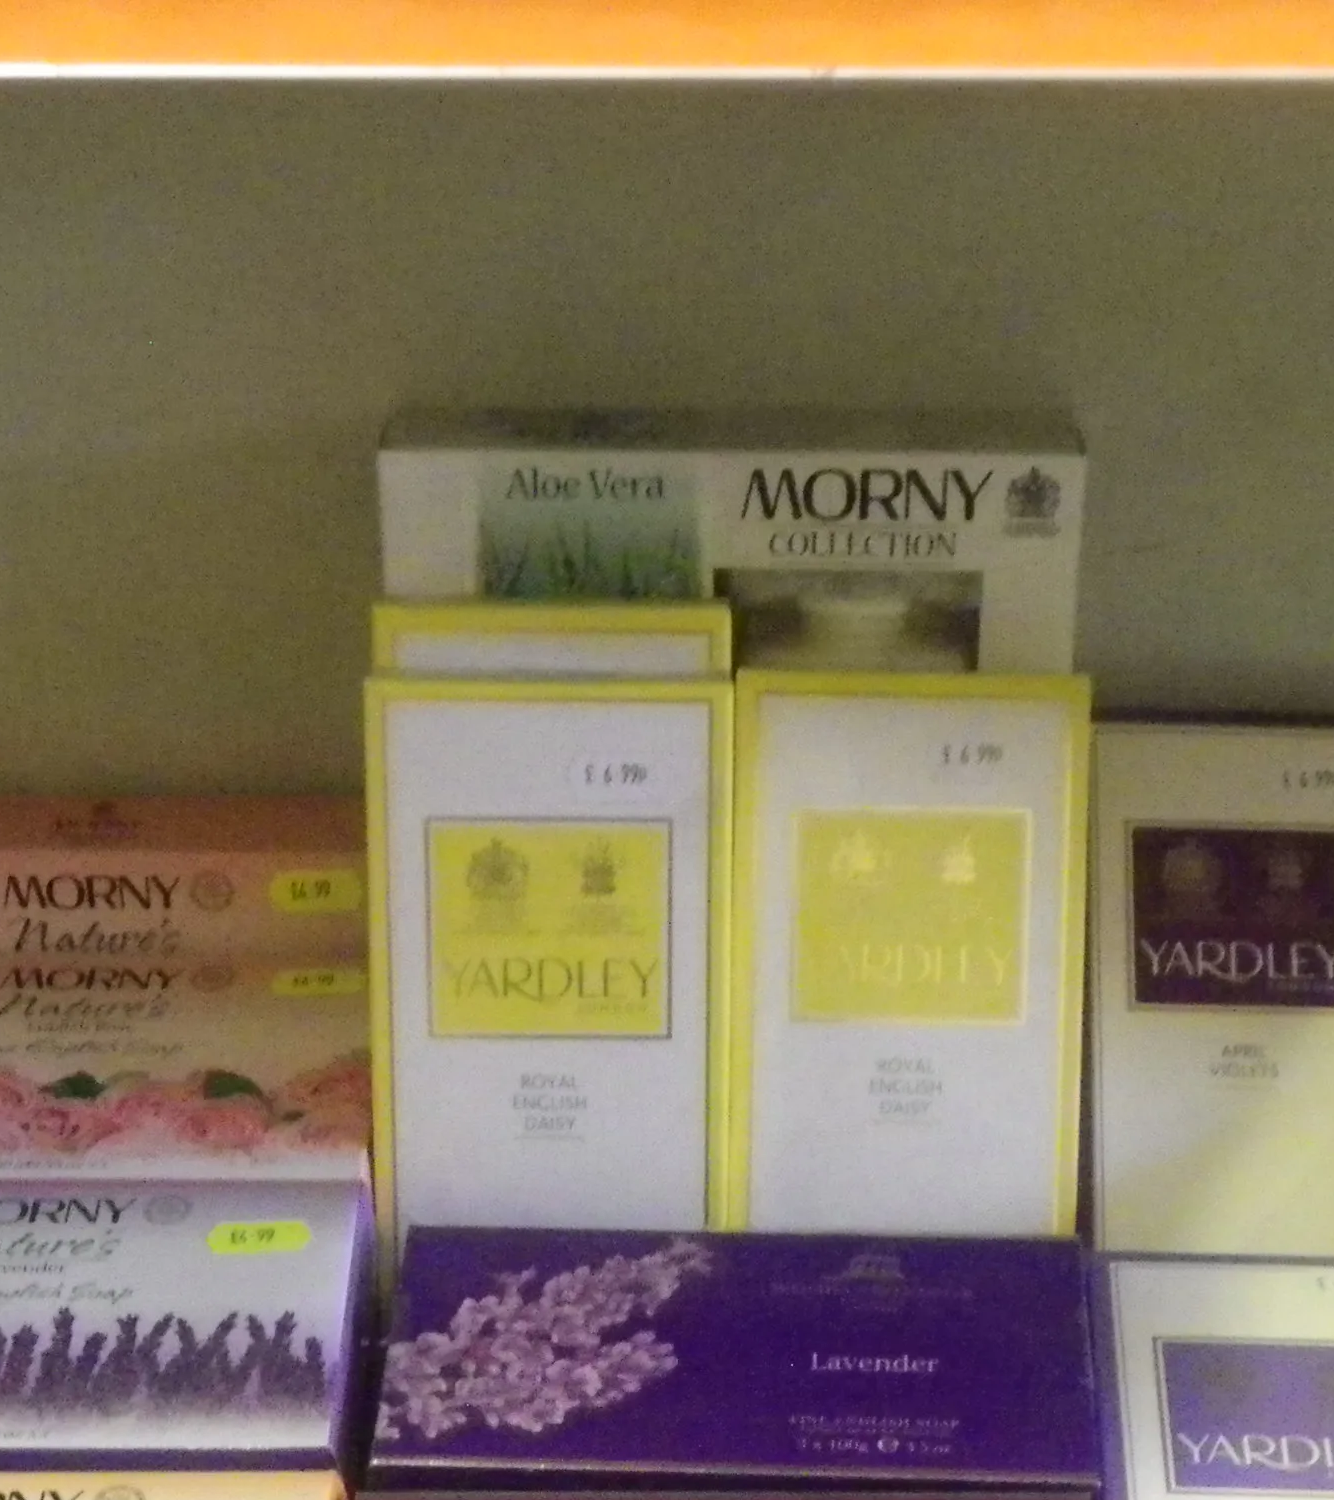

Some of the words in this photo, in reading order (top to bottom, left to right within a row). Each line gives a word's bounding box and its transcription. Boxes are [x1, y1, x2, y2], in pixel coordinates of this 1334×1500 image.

[506, 468, 581, 501] Aloe
[586, 468, 665, 501] Vera
[741, 467, 994, 522] MORNY
[768, 530, 959, 559] COLLECTION
[2, 874, 182, 910] MORNY
[14, 914, 182, 955] Nature's
[0, 967, 184, 991] MORNY
[444, 957, 659, 1004] YARDLEY
[810, 1352, 940, 1373] Lavender
